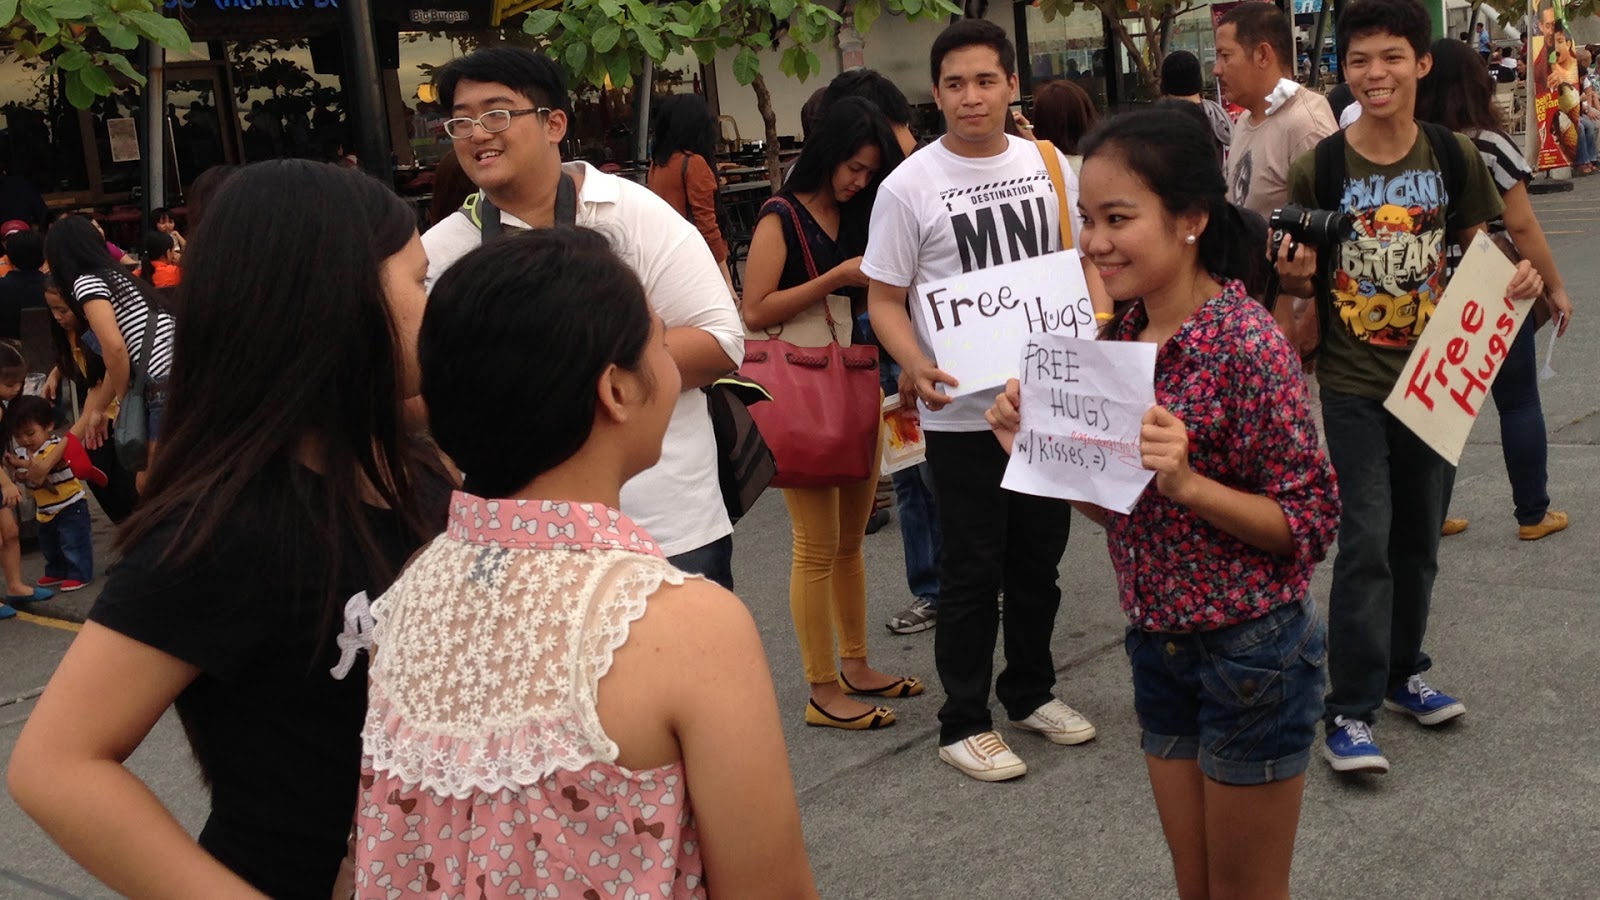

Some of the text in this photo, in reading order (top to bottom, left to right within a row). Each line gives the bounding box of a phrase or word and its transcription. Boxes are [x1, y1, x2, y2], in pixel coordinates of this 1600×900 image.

[412, 10, 469, 23] Big Burgers
[971, 184, 1034, 205] DESTINATION
[1341, 229, 1443, 281] BREAK
[926, 286, 1092, 338] Free Hugs
[1331, 290, 1436, 338] ROCK
[1025, 340, 1079, 384] FREE
[1404, 300, 1485, 412] Free
[1050, 387, 1110, 431] HUGS
